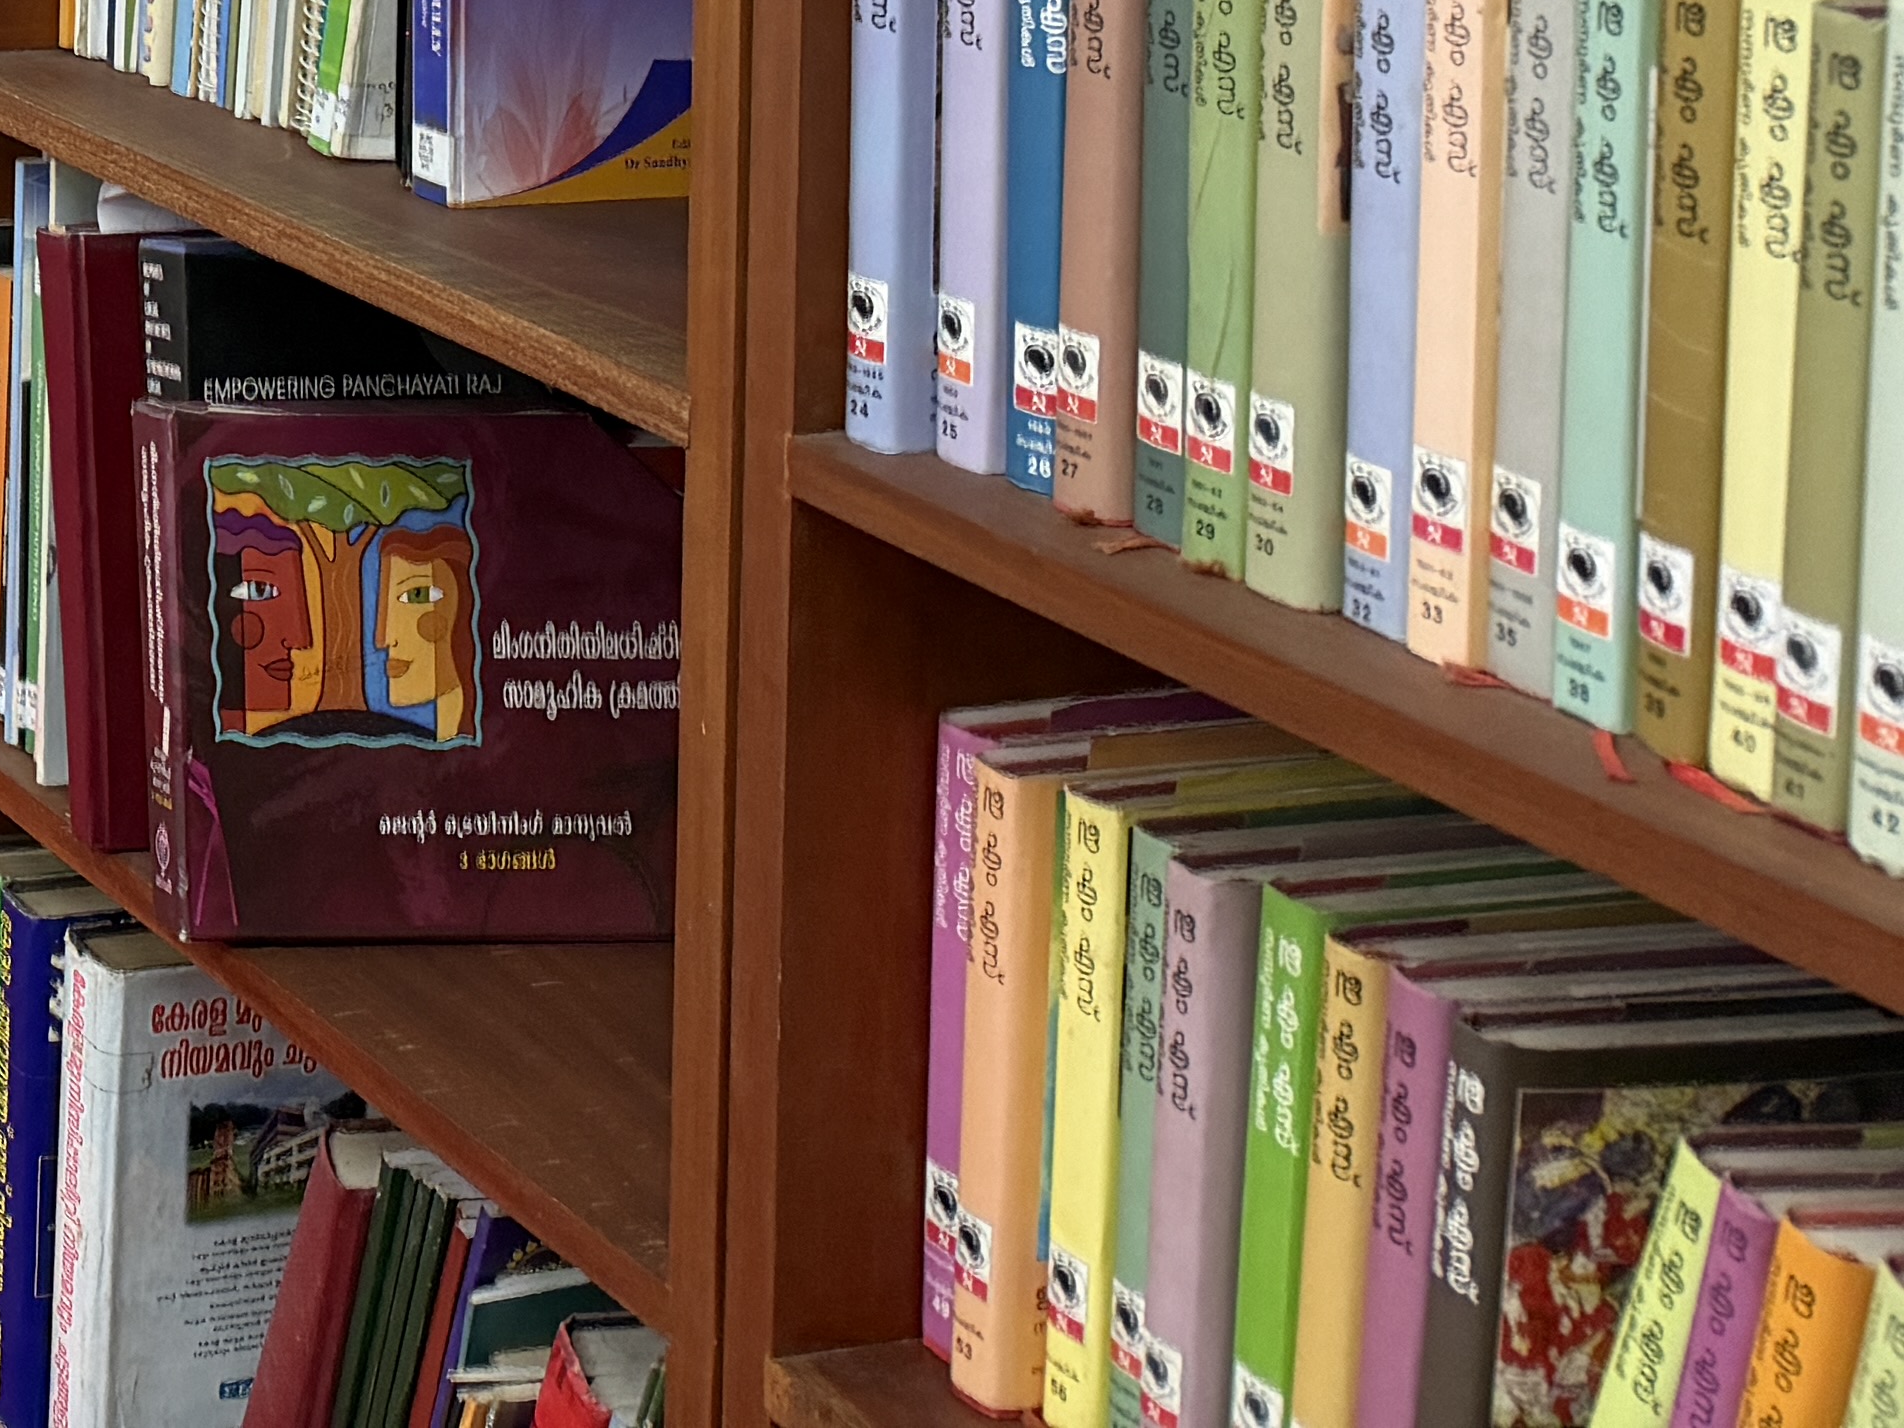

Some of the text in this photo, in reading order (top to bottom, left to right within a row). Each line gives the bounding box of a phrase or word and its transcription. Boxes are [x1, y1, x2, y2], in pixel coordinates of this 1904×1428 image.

[625, 159, 639, 169] Dr
[204, 373, 502, 404] EMPOWERING PANCHAYATI RAJ
[941, 418, 958, 440] 25
[1027, 454, 1053, 479] 26
[1061, 457, 1079, 480] 27
[1195, 518, 1216, 542] 29
[1420, 599, 1444, 625] 33
[1494, 620, 1519, 647] 35
[503, 669, 602, 721] സാമൂഹിക
[984, 785, 1005, 888] ഇ എം
[1279, 934, 1302, 1049] ഇ എം
[152, 997, 228, 1036] കേരള
[161, 1039, 275, 1078] നിയമവും
